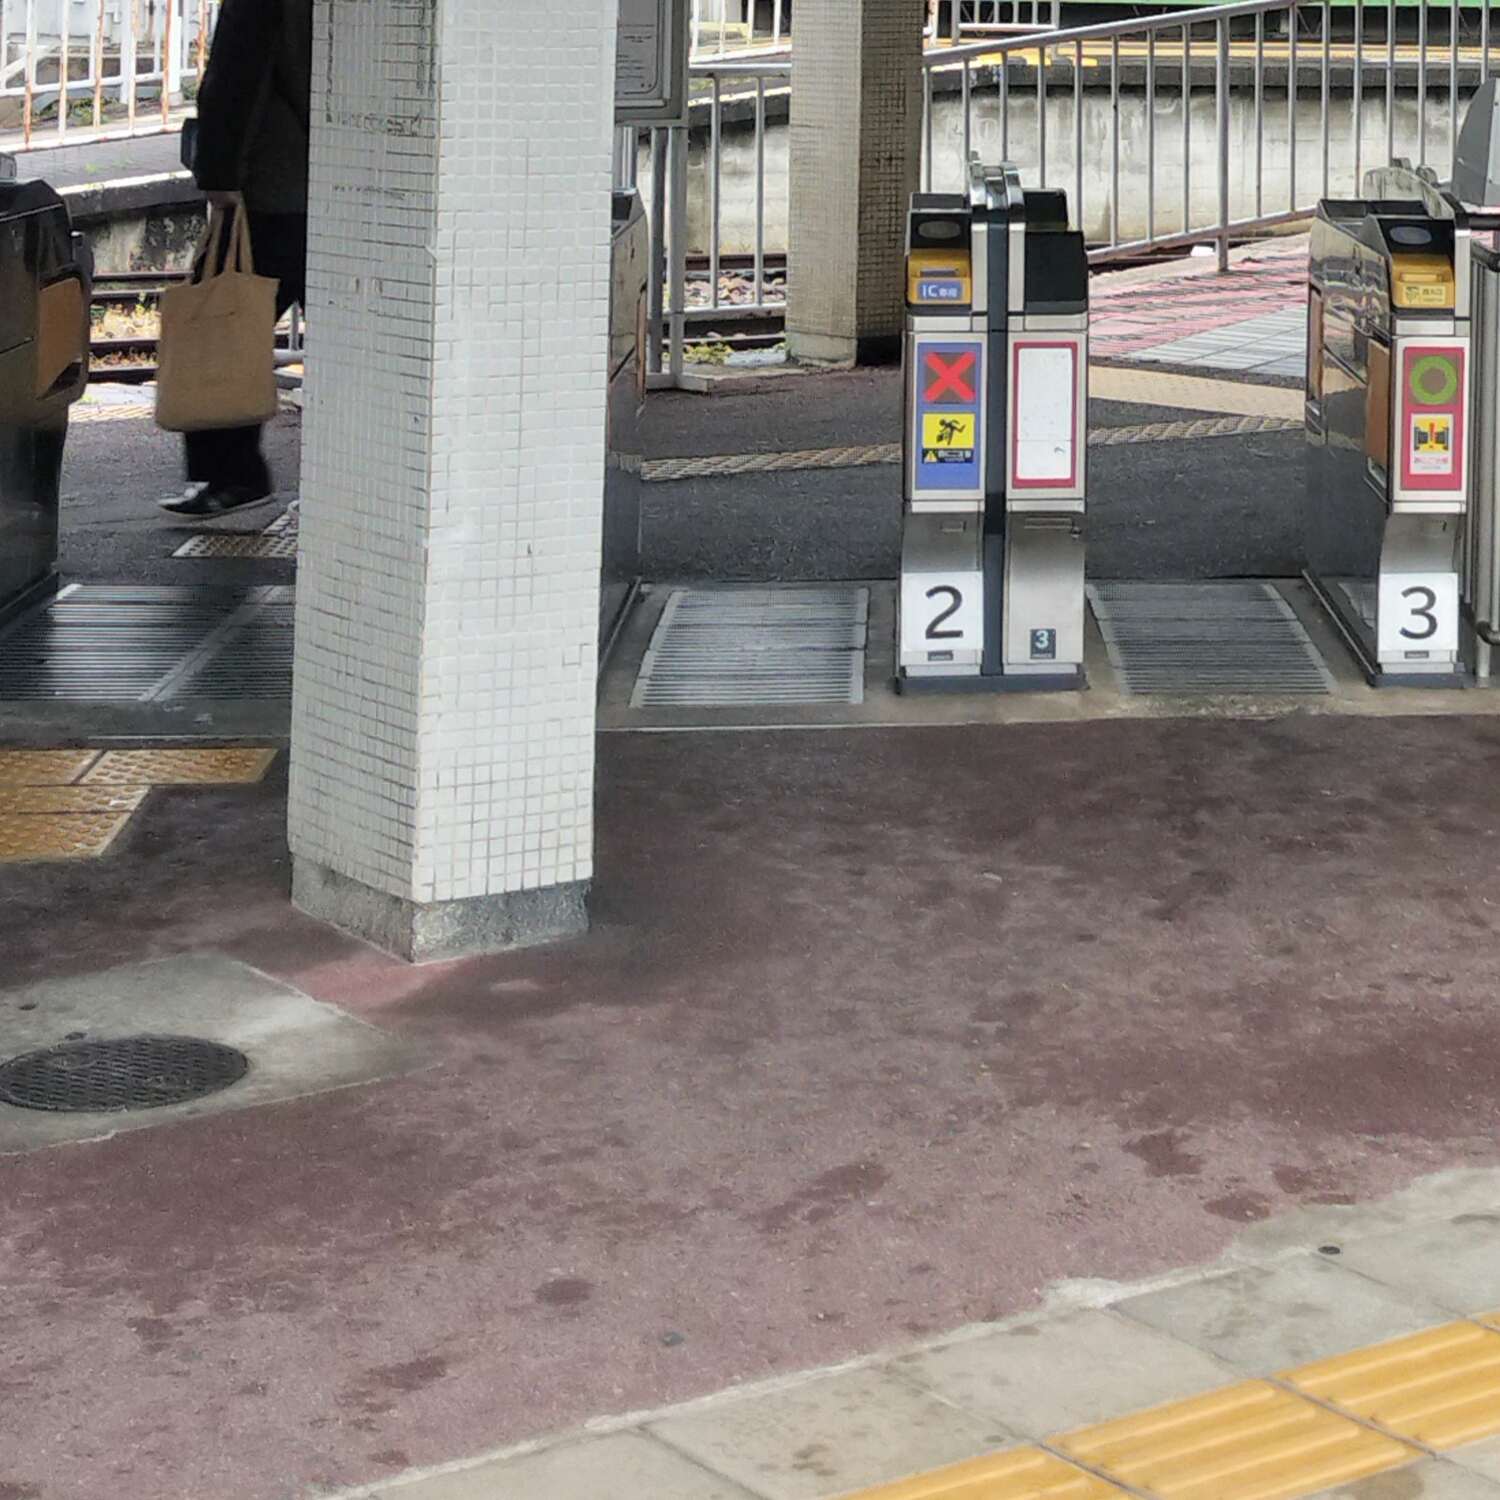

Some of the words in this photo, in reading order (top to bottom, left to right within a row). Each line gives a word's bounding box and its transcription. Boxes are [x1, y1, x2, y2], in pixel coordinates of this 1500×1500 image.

[924, 584, 964, 640] 2
[1398, 585, 1439, 640] 3
[1035, 629, 1049, 651] 3
